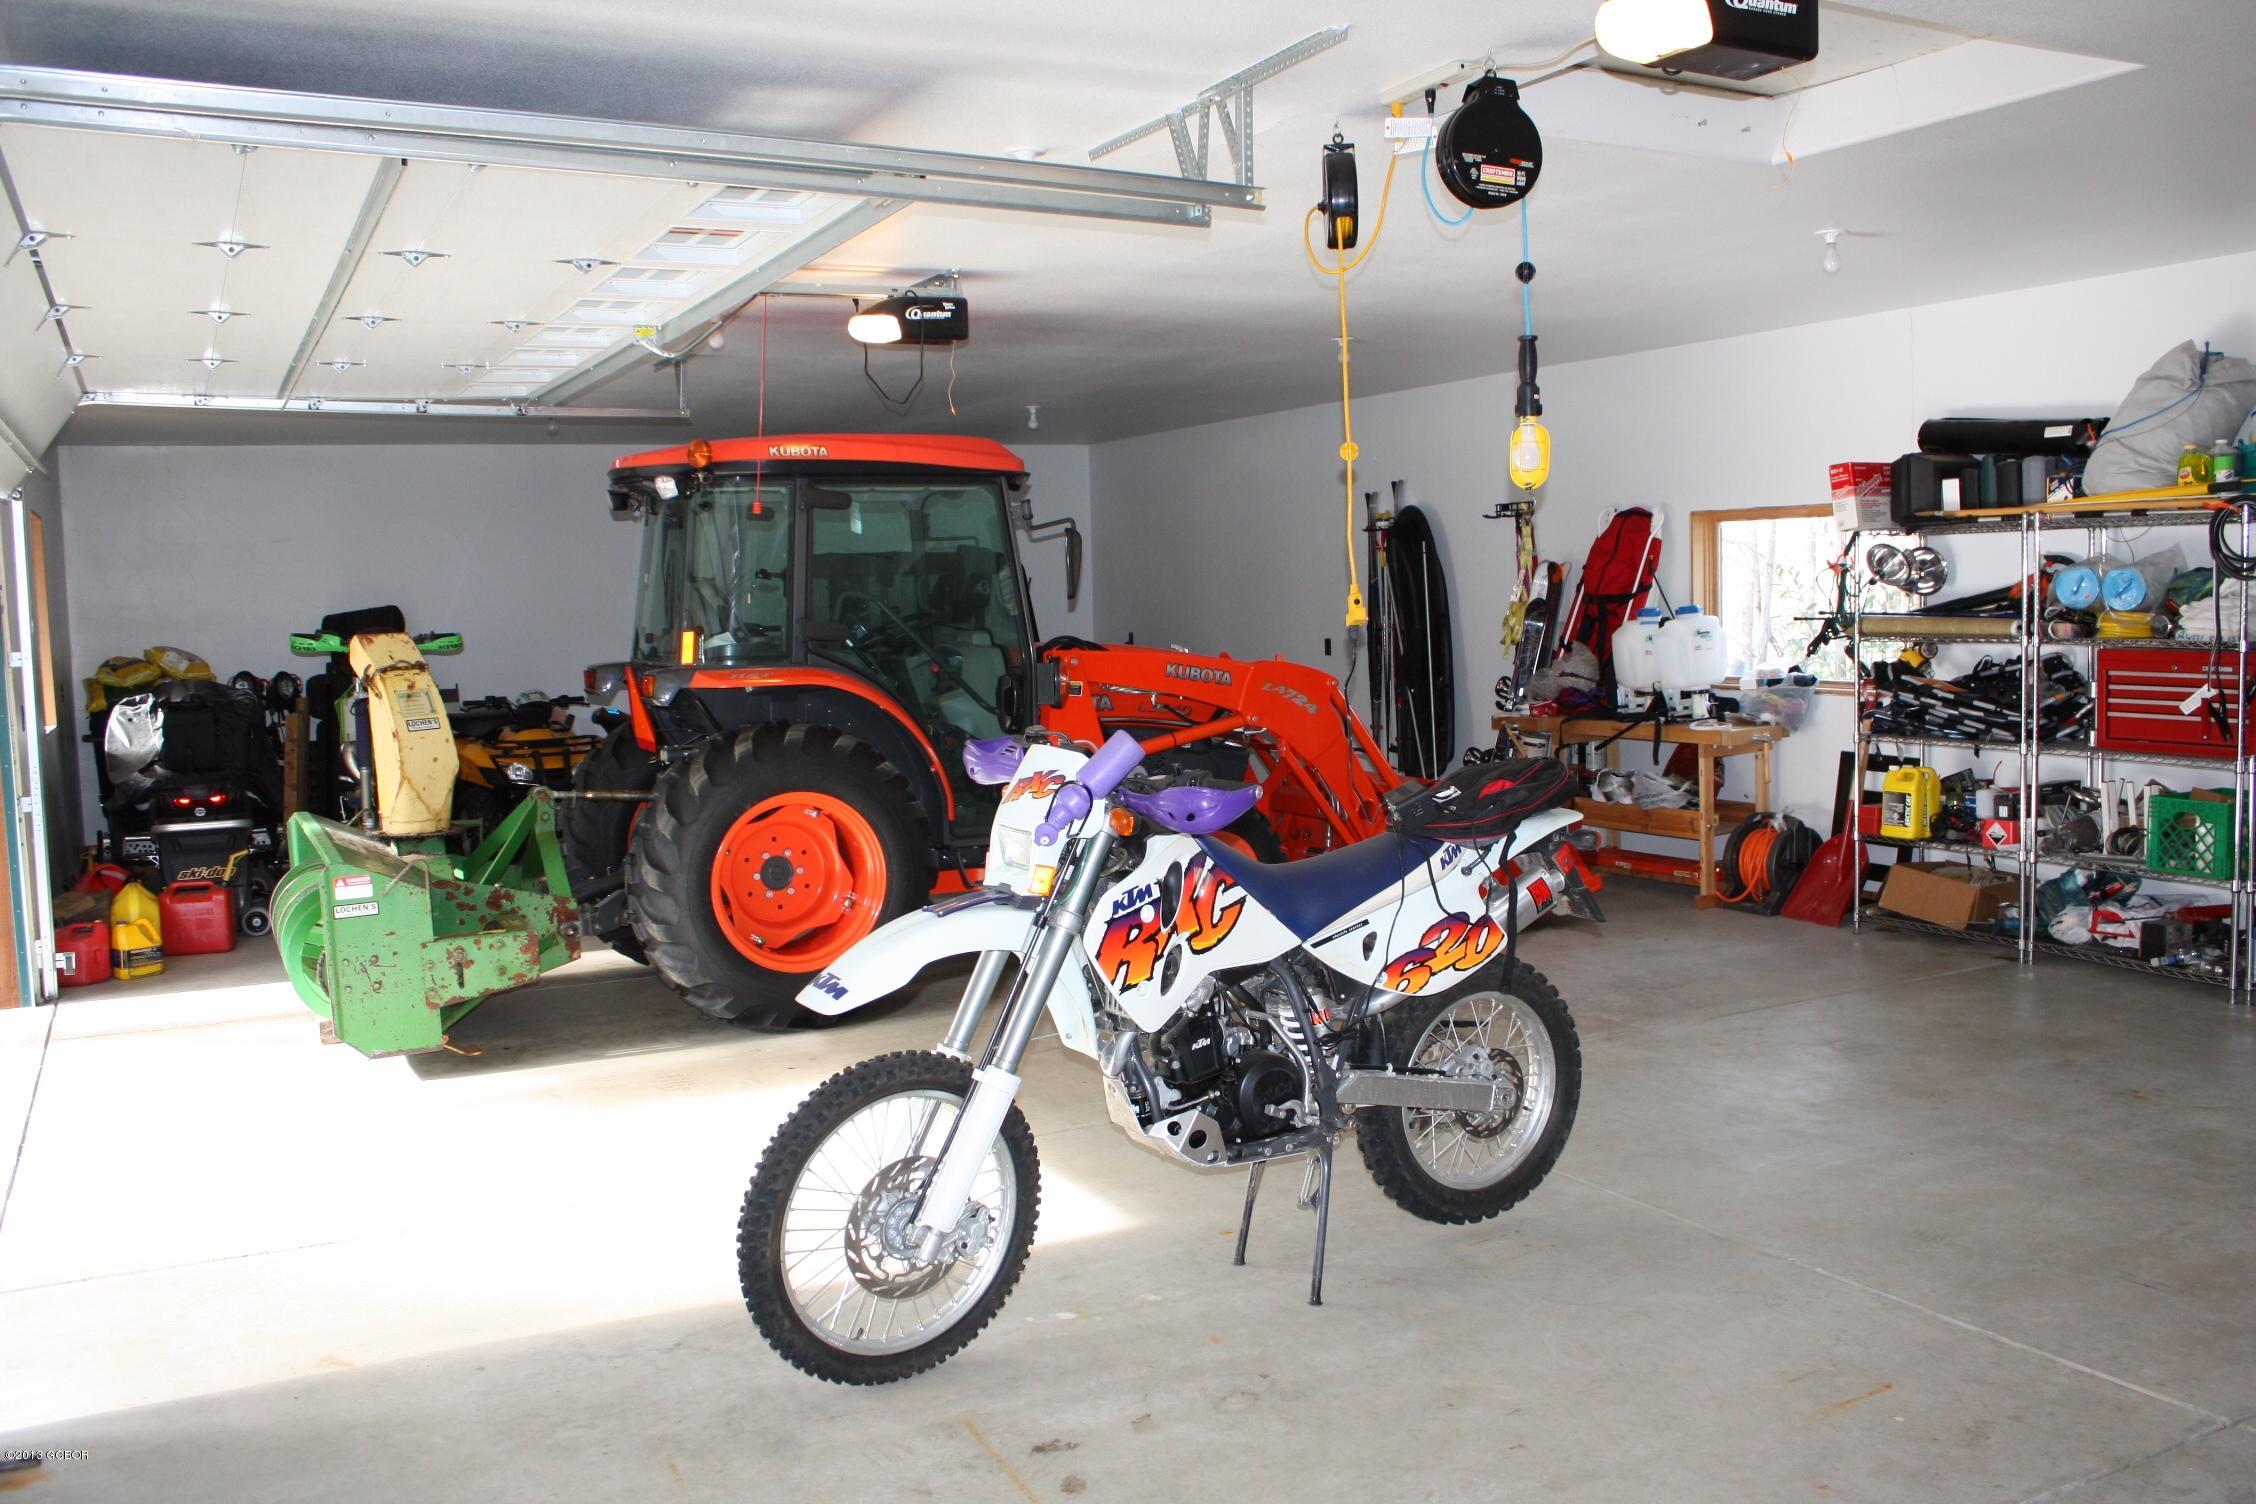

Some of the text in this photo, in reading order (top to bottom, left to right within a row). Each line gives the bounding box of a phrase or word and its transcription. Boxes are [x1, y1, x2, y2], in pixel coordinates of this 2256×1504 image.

[1481, 166, 1514, 178] CRAFTSMAN
[768, 446, 828, 457] KUBOTA
[1166, 662, 1232, 686] KUBOTA
[1439, 844, 1462, 871] KTM
[1112, 884, 1153, 916] KTM
[1383, 911, 1506, 994] 620
[808, 972, 849, 1001] KTM
[1191, 1037, 1211, 1051] KTM
